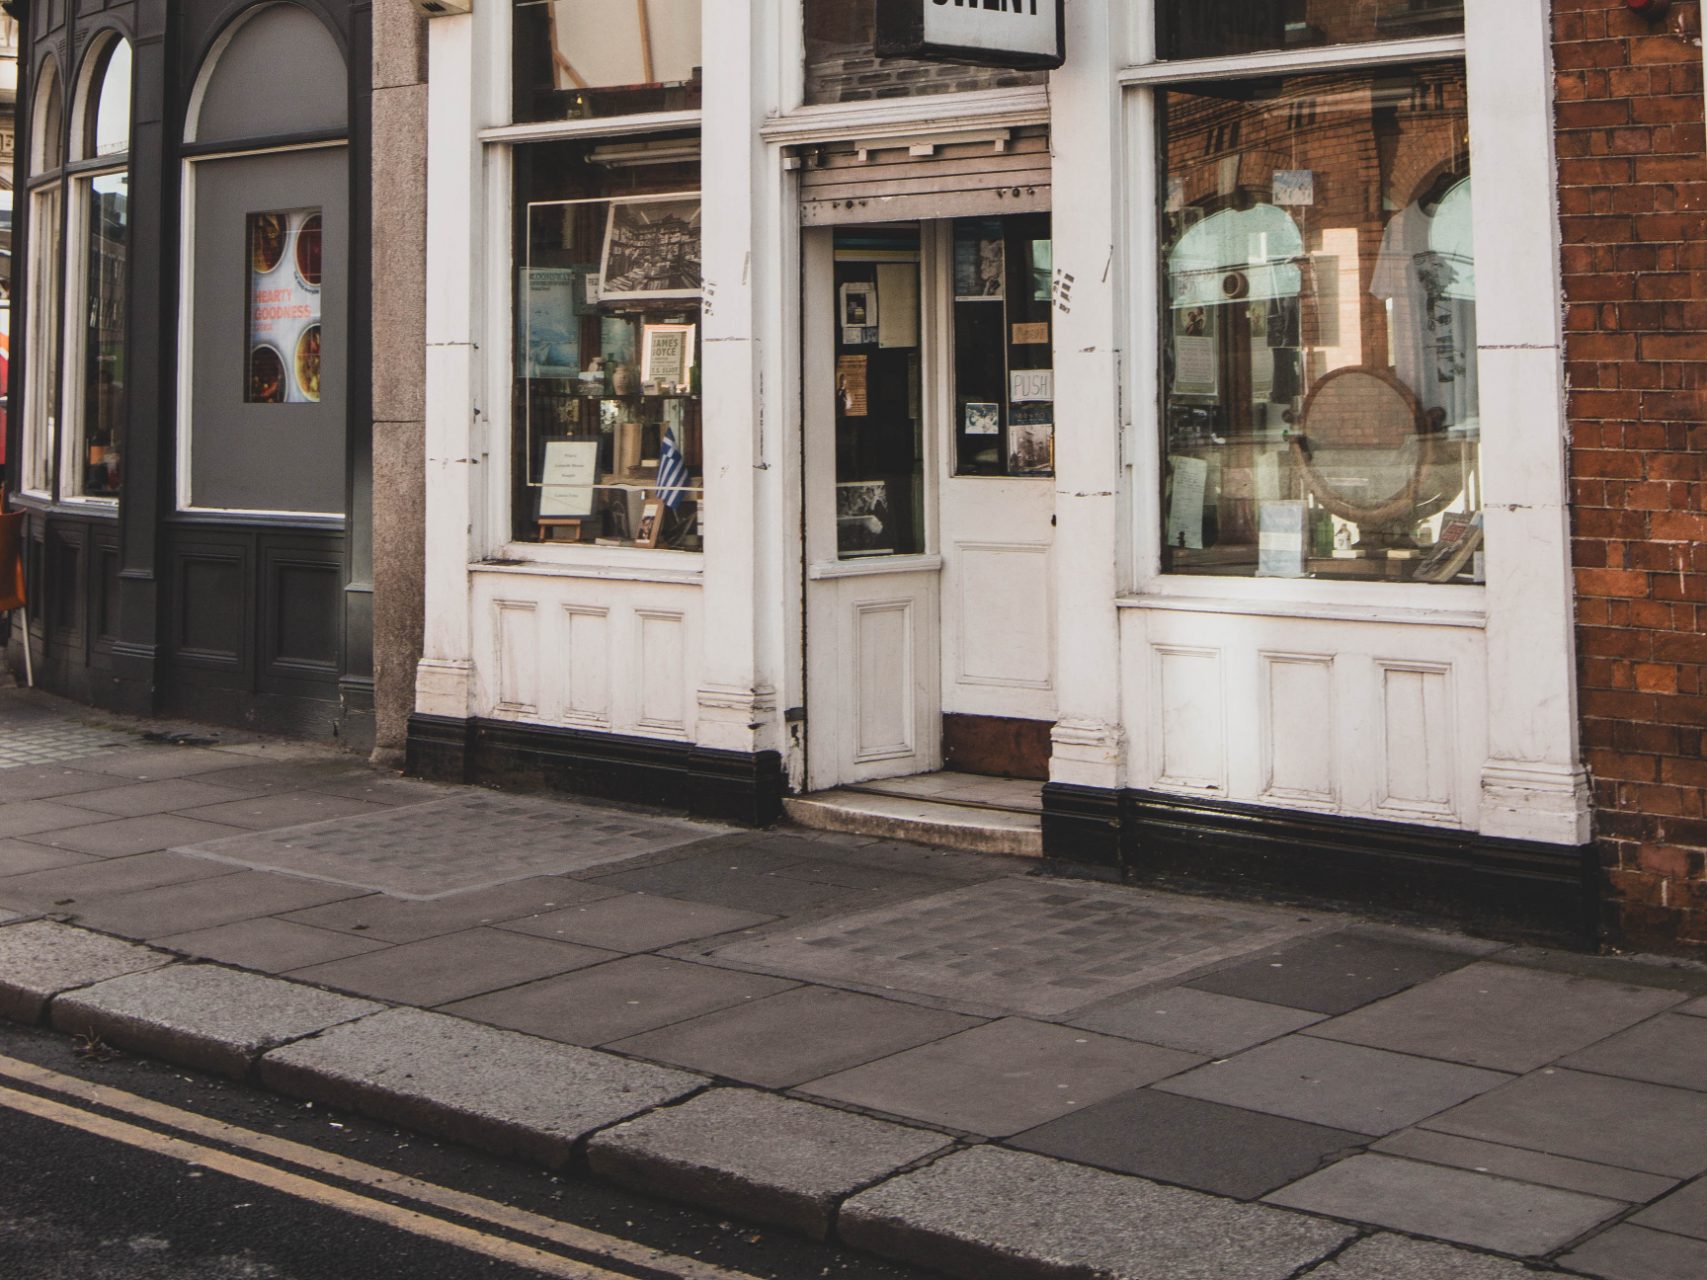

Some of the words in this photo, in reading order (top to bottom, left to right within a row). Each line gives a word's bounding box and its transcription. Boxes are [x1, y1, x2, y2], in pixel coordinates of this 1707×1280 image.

[652, 339, 679, 348] JAMES
[652, 348, 676, 357] JOYCE
[1014, 374, 1048, 397] PUSH
